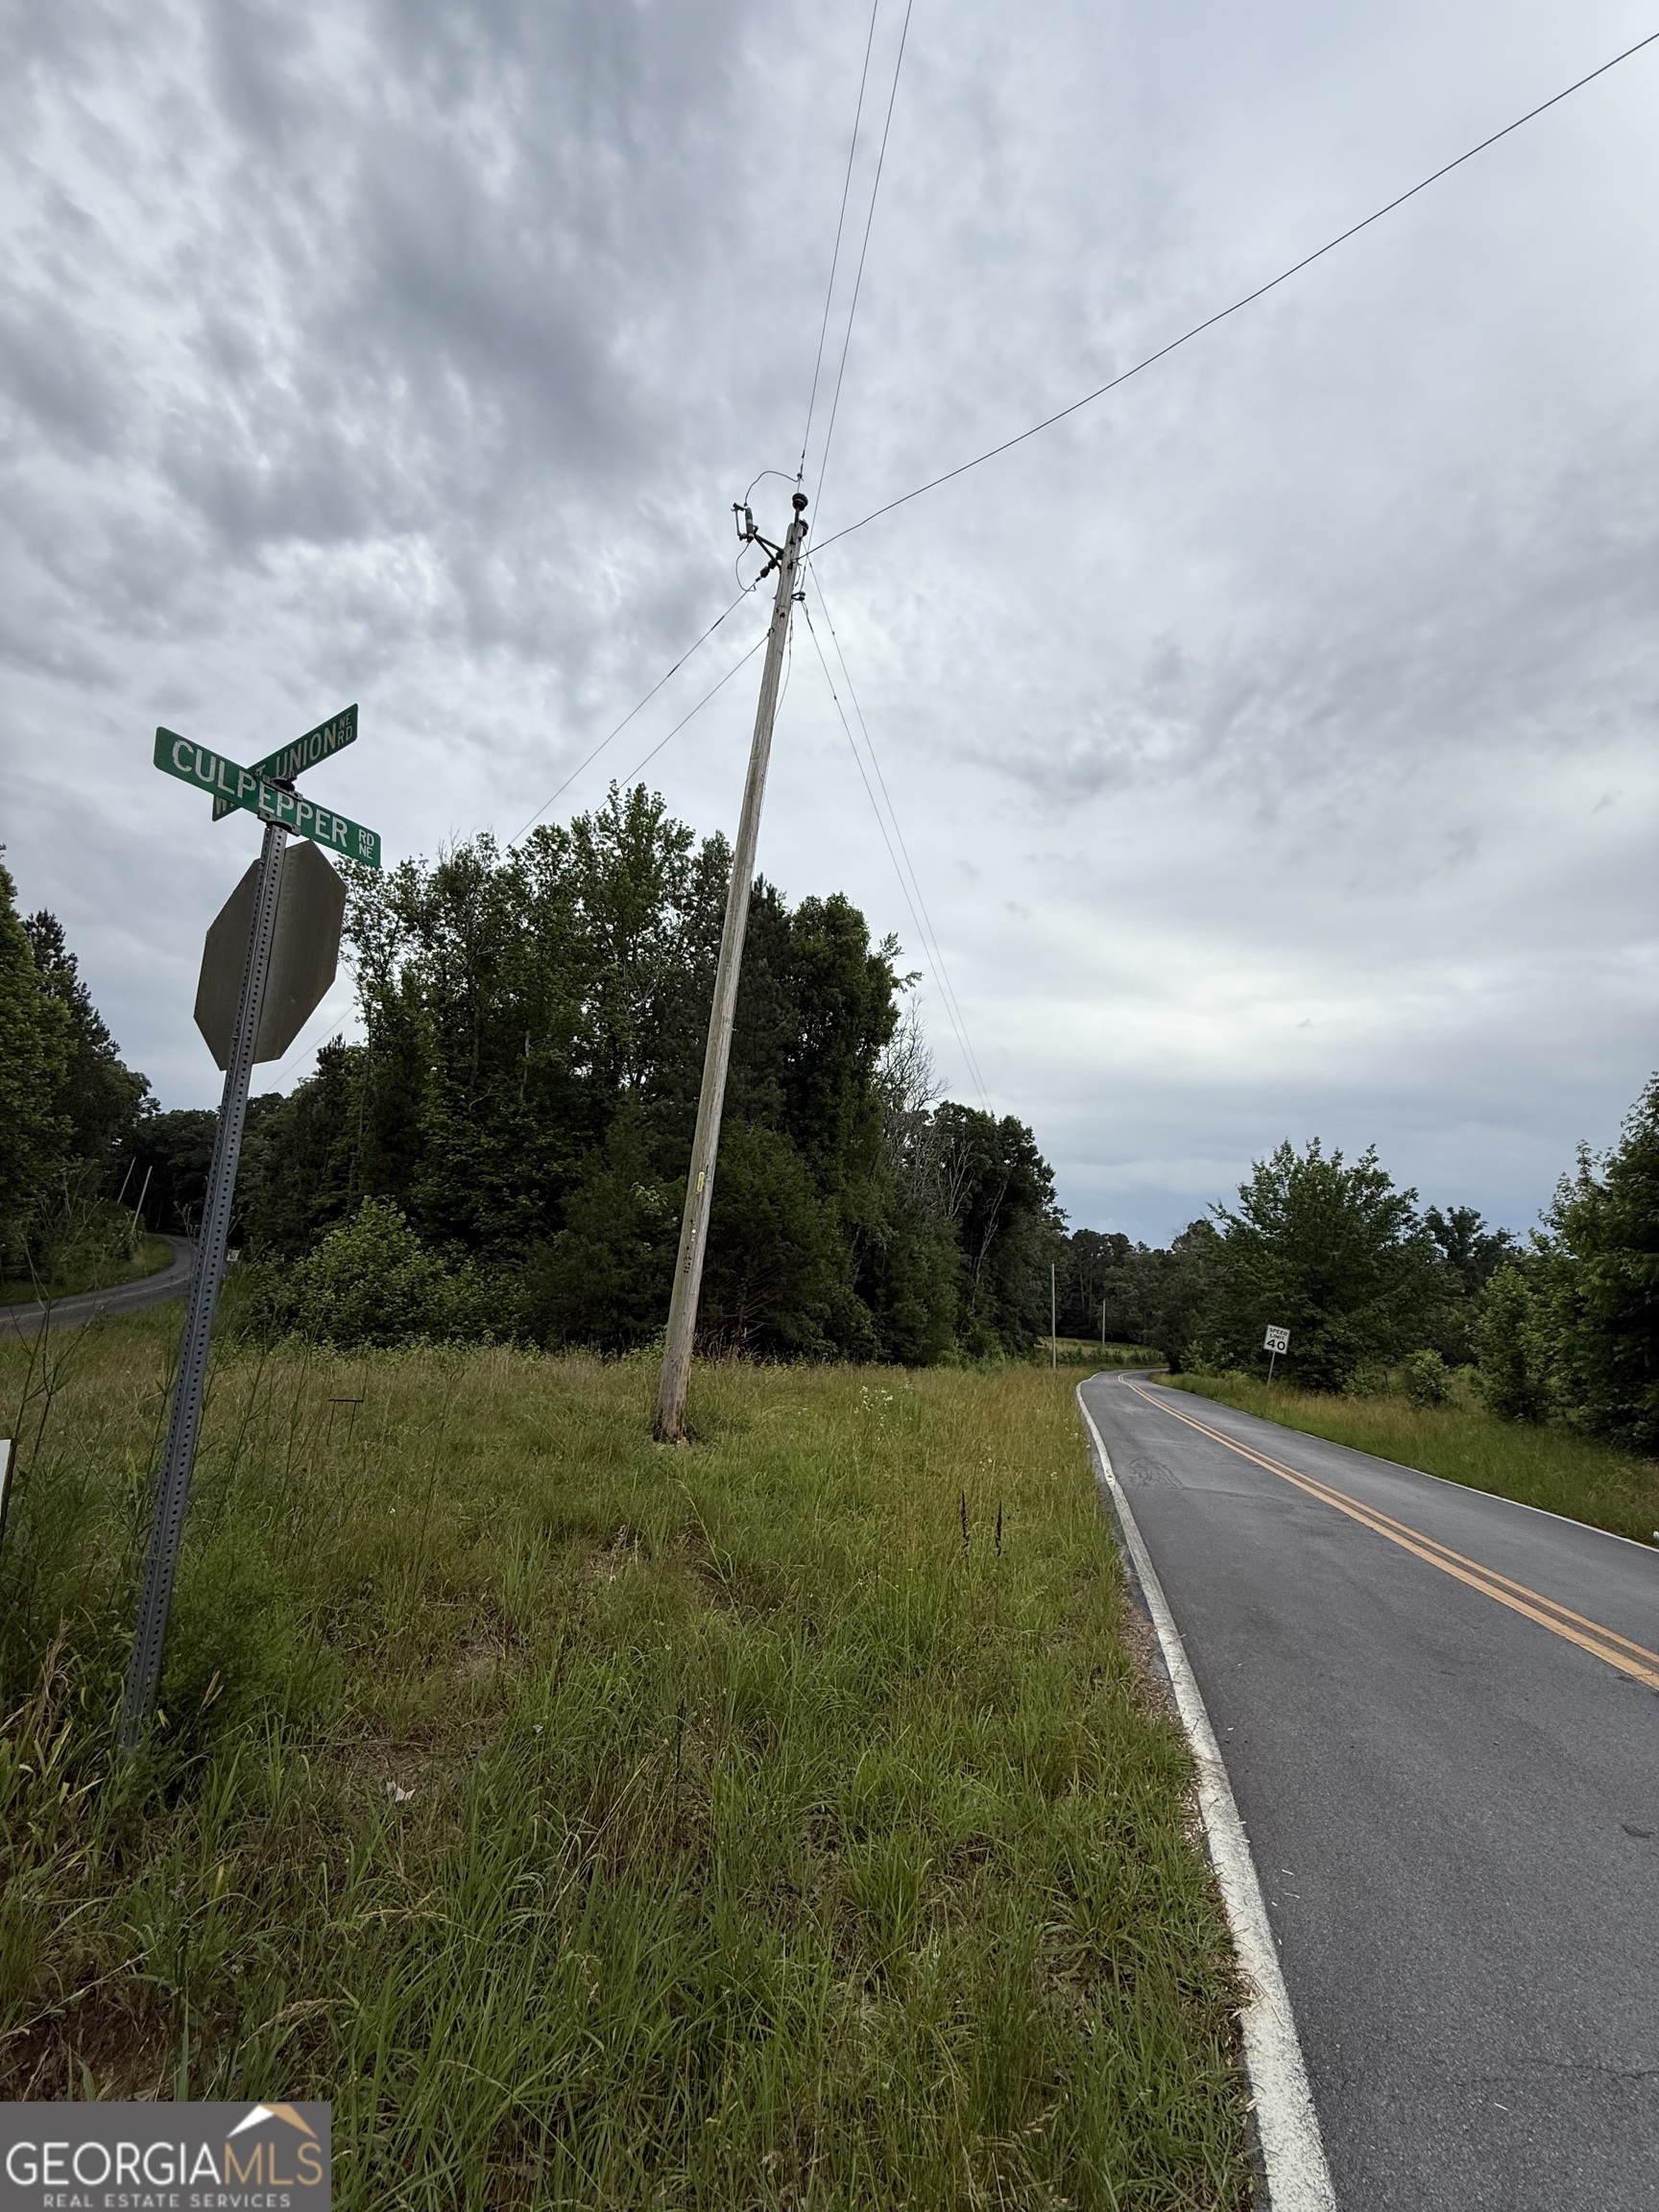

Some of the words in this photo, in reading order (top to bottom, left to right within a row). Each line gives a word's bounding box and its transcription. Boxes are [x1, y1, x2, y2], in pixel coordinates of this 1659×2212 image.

[340, 712, 352, 730] NE
[337, 726, 353, 747] RD
[276, 723, 337, 779] UNION
[173, 739, 348, 848] CULPEPPER
[358, 829, 375, 848] RD
[358, 842, 373, 860] NE
[1269, 1328, 1288, 1336] SPEED
[1266, 1338, 1286, 1351] 40
